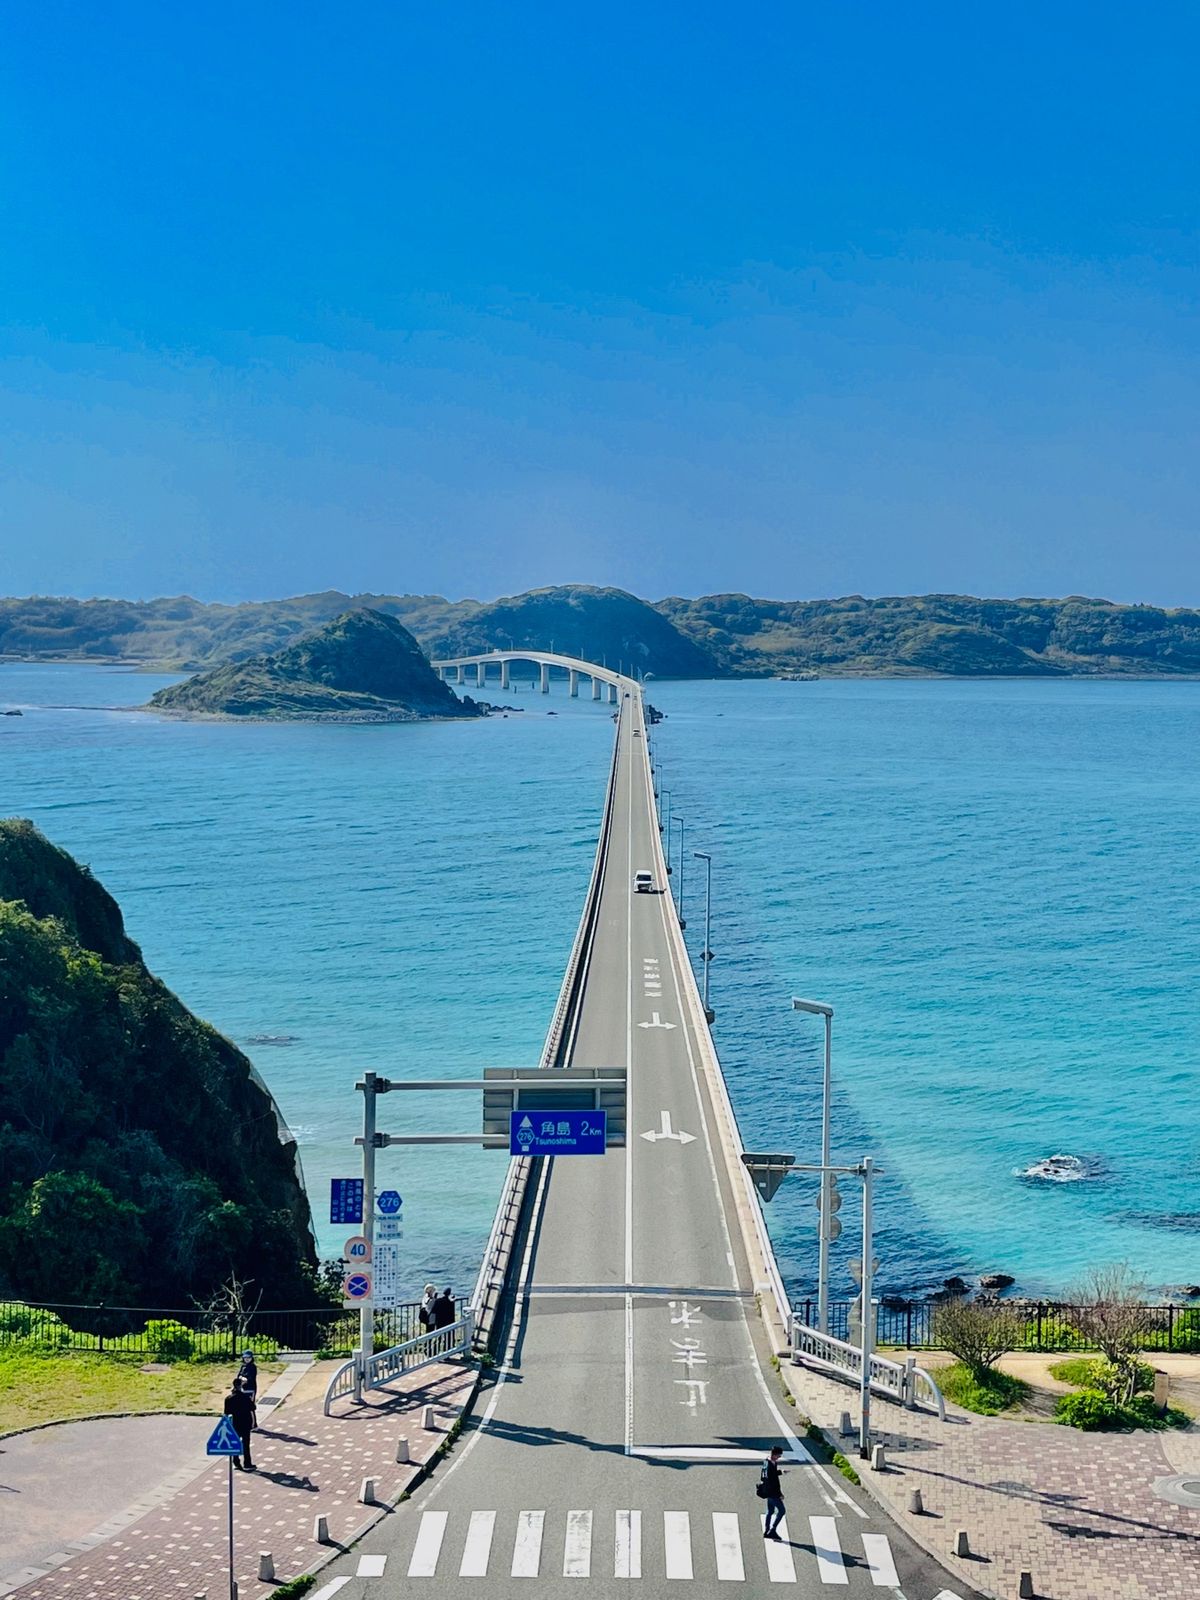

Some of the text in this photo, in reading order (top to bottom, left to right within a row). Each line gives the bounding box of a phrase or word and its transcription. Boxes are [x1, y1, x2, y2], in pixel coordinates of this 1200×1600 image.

[541, 1121, 571, 1136] 角島
[519, 1132, 532, 1141] 276
[535, 1137, 577, 1145] Tsunoshima
[379, 1197, 400, 1208] 276
[350, 1243, 366, 1256] 40
[667, 1301, 710, 1416] 止まれ
